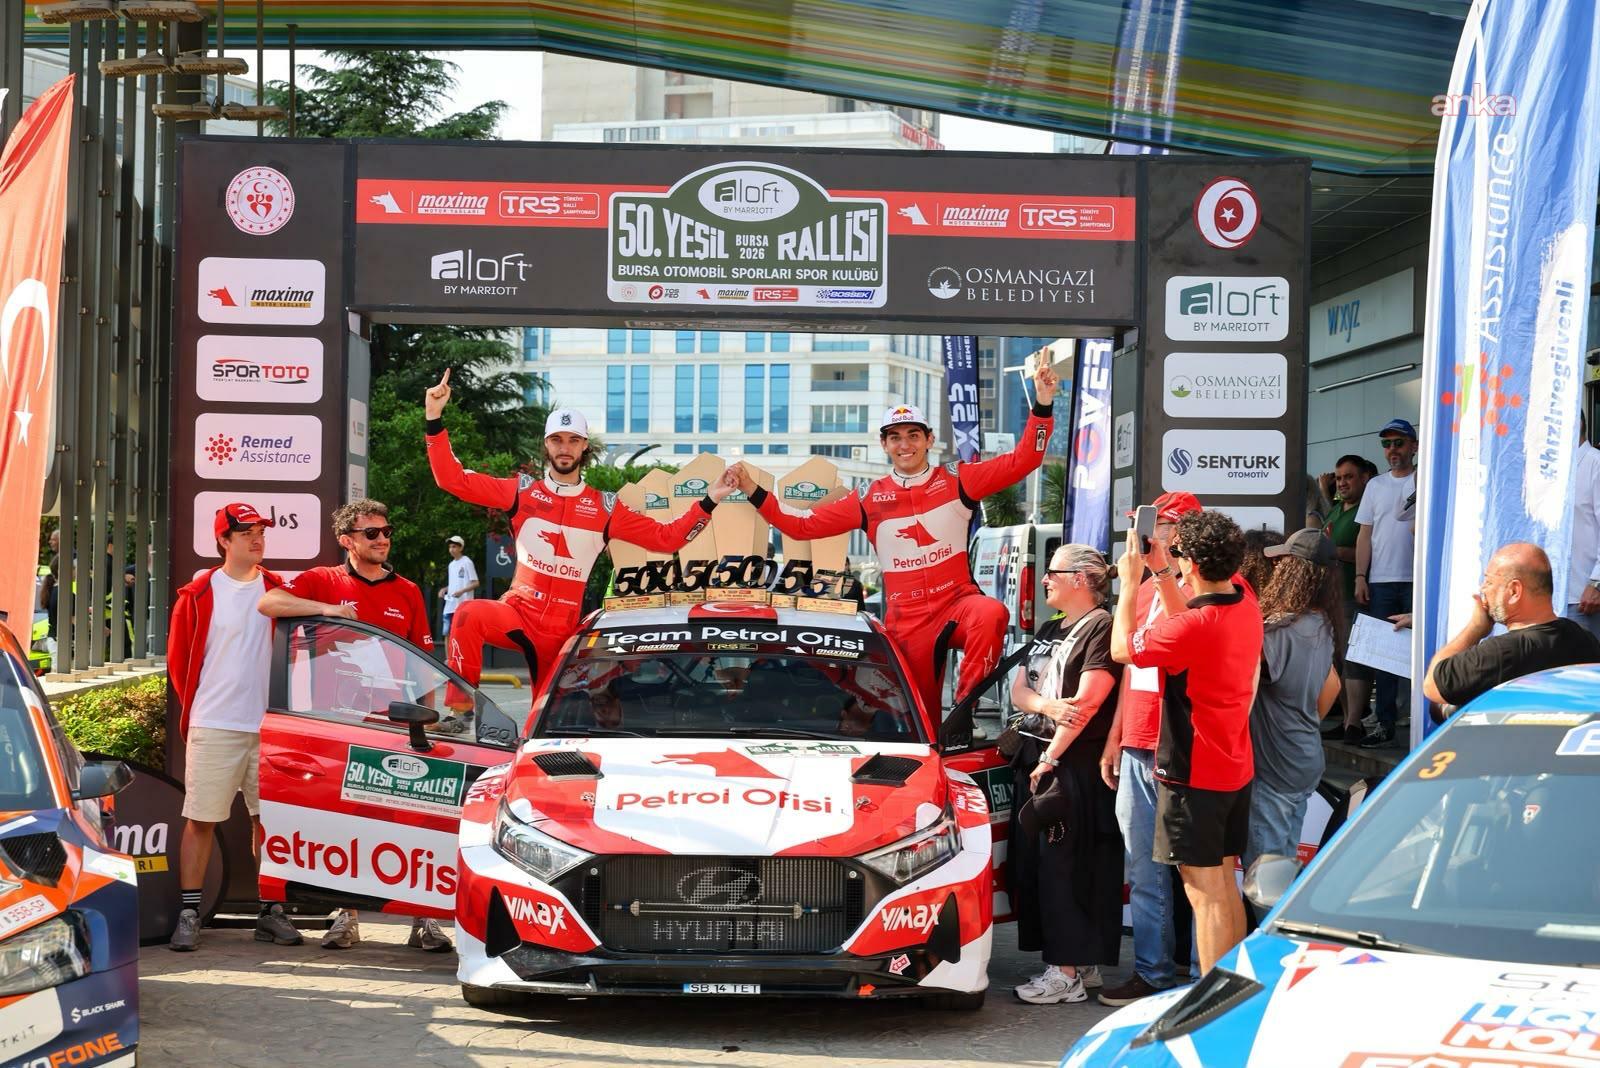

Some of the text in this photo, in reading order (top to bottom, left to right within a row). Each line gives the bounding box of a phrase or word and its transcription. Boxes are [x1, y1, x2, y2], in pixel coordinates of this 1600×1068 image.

[417, 191, 490, 209] maxima
[714, 178, 784, 204] aloft
[502, 195, 561, 215] TRS
[723, 206, 774, 215] BY MARRIOTT
[943, 204, 1010, 221] maxima
[1022, 207, 1079, 228] TRS
[618, 203, 730, 260] 50. YEŞİL
[735, 234, 769, 247] BURSA
[777, 208, 878, 262] RALLİSİ
[1478, 133, 1517, 344] Assistance
[739, 247, 766, 260] 2026
[431, 249, 530, 282] aloft
[618, 263, 879, 282] BURSA OTOMOBİL SPORLARI SPOR KULÜBÜ
[965, 266, 1095, 287] OSMANGAZİ
[251, 286, 314, 302] maxima
[444, 286, 518, 296] BY MARRIOTT
[717, 287, 750, 297] maxima
[755, 290, 783, 300] TRS
[967, 287, 1095, 304] BELEDİYESİ
[1179, 281, 1283, 316] aloft
[1193, 322, 1271, 332] BY MARRIOTT
[1195, 374, 1281, 388] OSMANGAZİ
[1195, 388, 1281, 401] BELEDİYESİ
[240, 435, 293, 449] Remed
[240, 450, 311, 465] Assistance
[1227, 469, 1270, 479] OTOMOTİV
[527, 553, 582, 578] Petrol Ofisi
[893, 544, 953, 569] Petrol Ofisi
[603, 626, 865, 651] Team Petrol Ofisi
[635, 643, 681, 652] maxima
[816, 648, 860, 659] maxima
[347, 761, 366, 783] 50.
[1418, 751, 1457, 780] 3
[616, 788, 833, 814] Petrol Ofisi
[371, 842, 457, 896] Ofis
[652, 920, 784, 942] HYUNDAI
[690, 983, 760, 993] SB 14 TET
[81, 999, 126, 1018] BLACK SHARK
